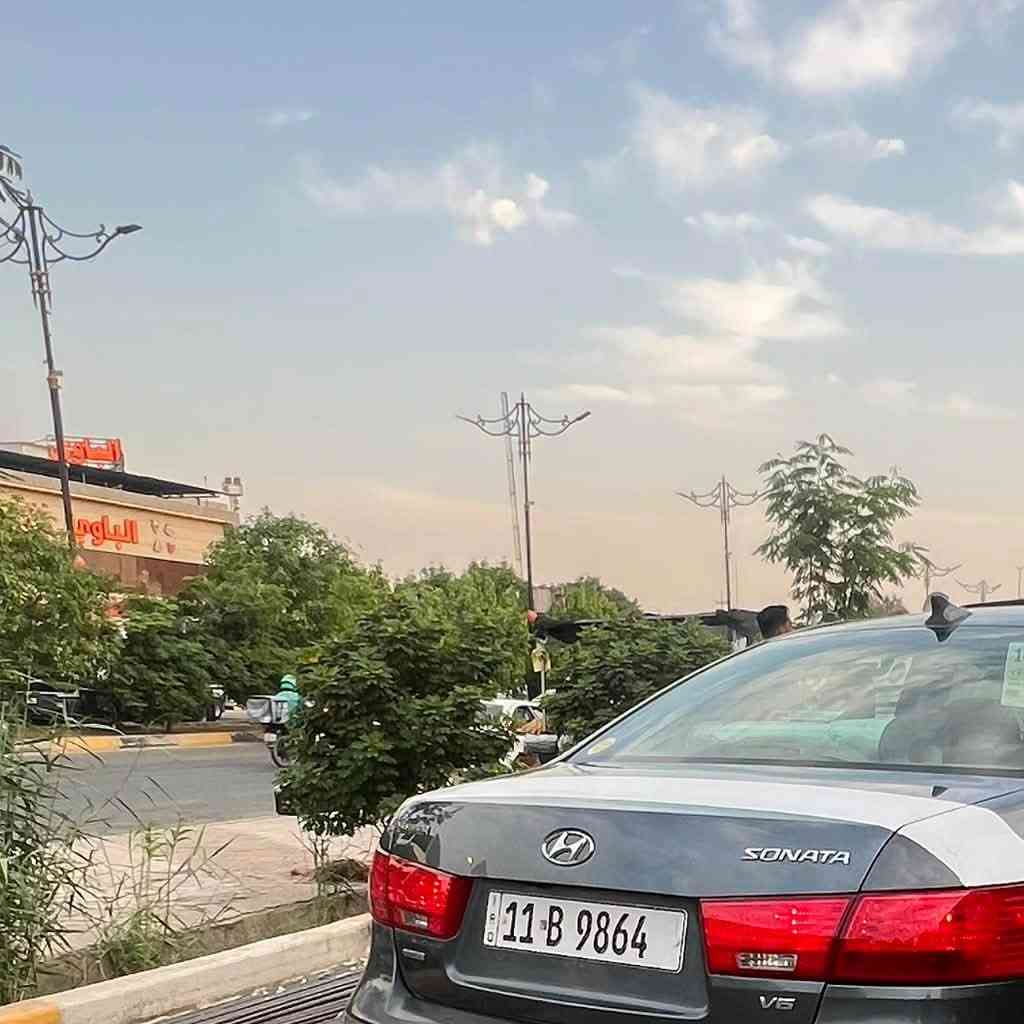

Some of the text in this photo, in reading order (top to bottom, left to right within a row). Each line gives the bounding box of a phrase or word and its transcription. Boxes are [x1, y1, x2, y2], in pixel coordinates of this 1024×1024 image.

[740, 847, 851, 866] SONATA
[503, 901, 534, 944] 11
[546, 905, 564, 947] B
[576, 909, 648, 959] 9864
[759, 995, 797, 1010] V6
